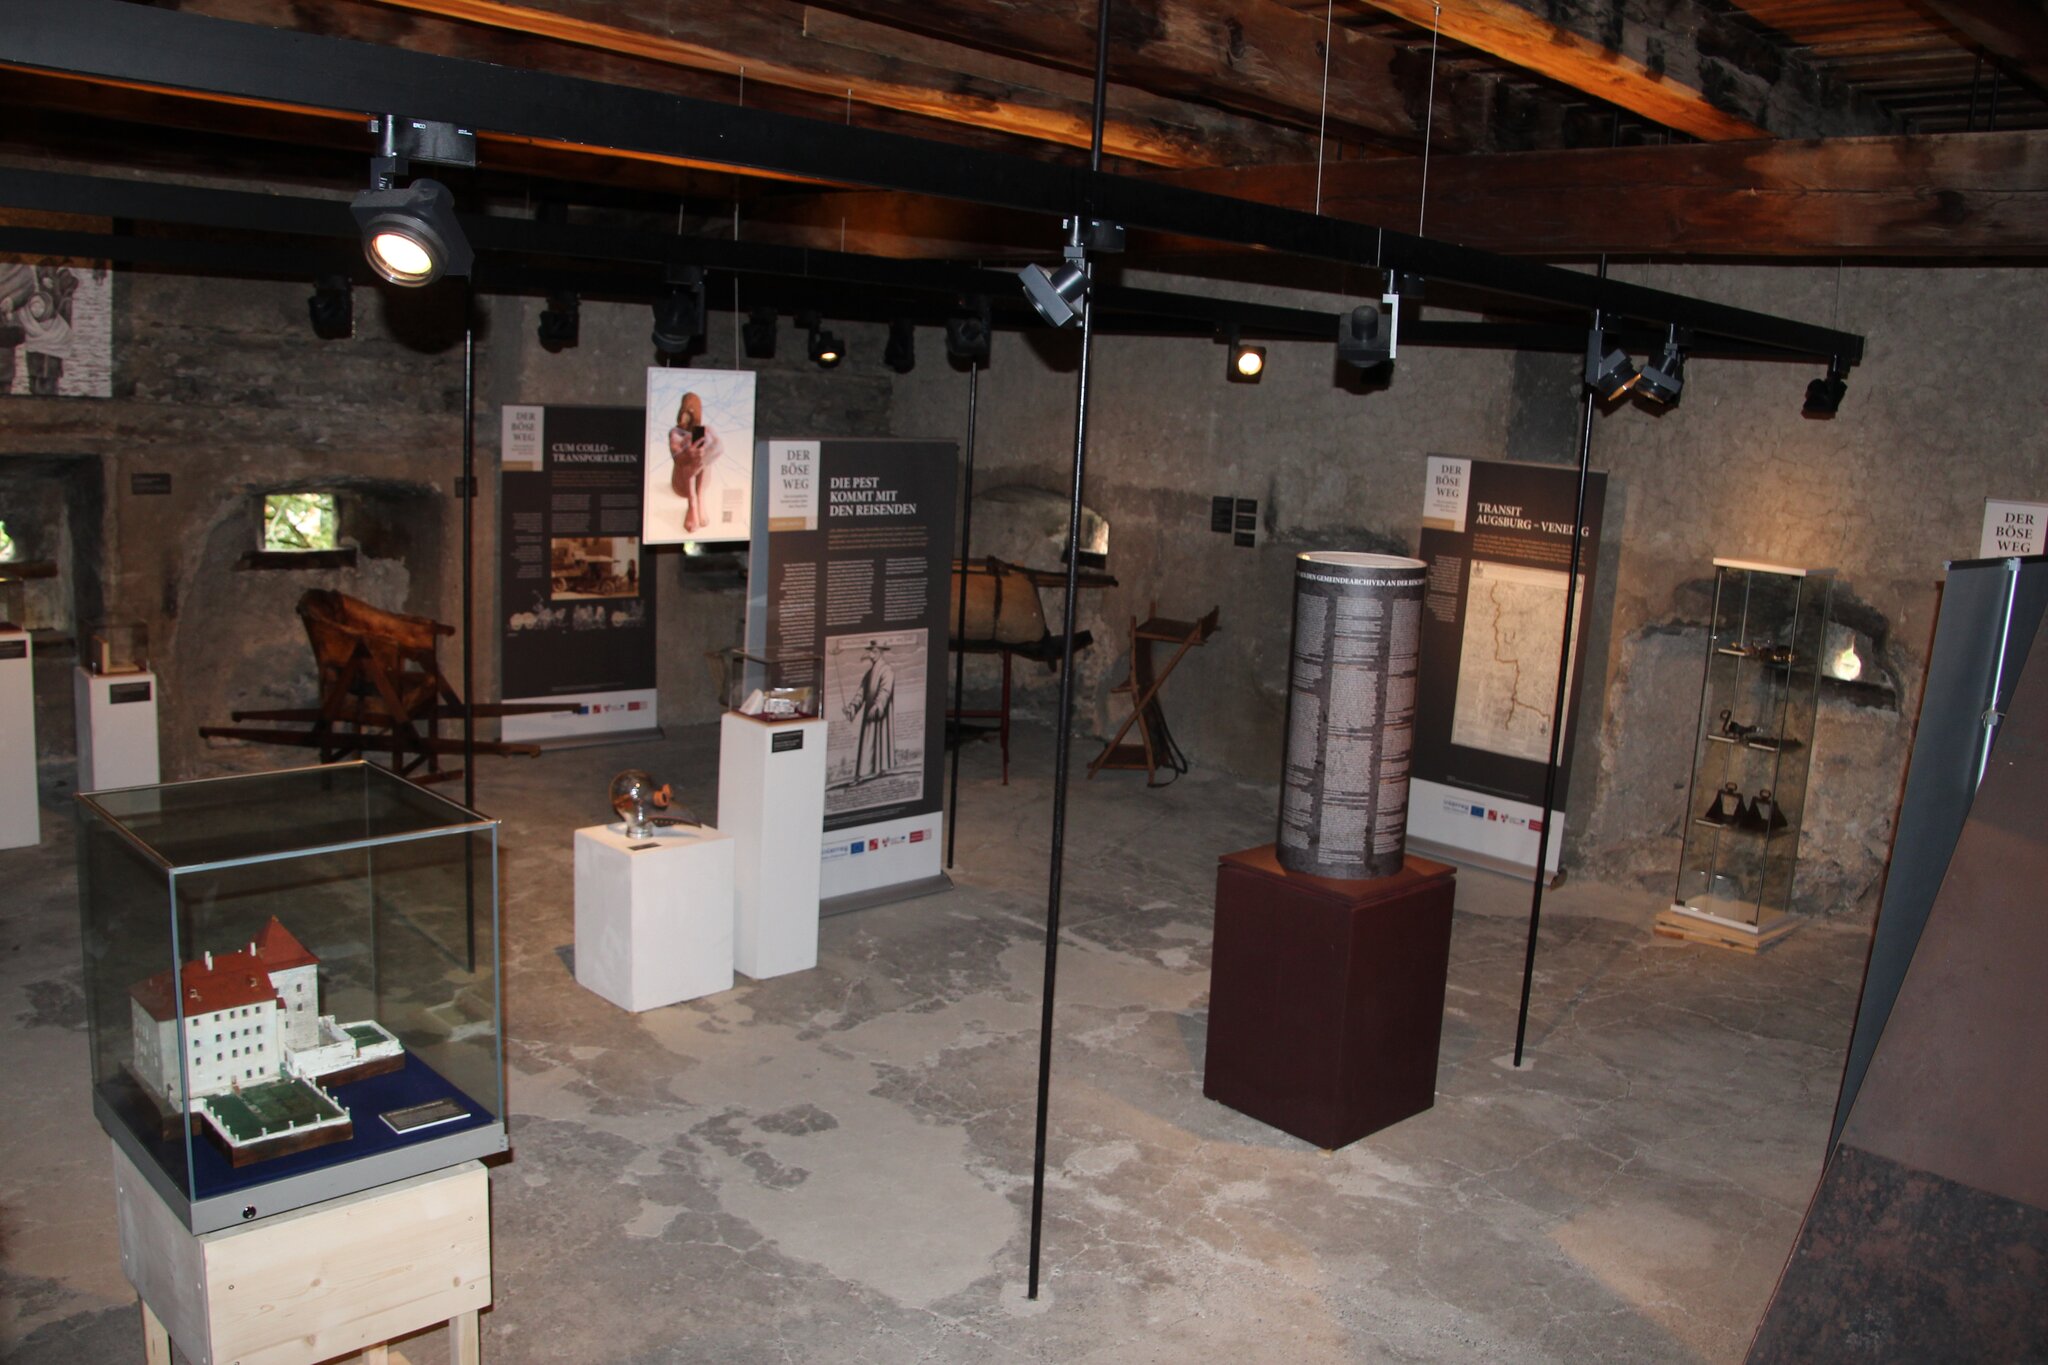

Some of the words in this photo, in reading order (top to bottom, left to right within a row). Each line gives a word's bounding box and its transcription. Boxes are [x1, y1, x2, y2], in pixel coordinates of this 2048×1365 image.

[516, 412, 536, 421] DER
[513, 433, 536, 442] WEG
[552, 443, 575, 453] CUM
[576, 443, 608, 453] COLLO
[552, 453, 638, 463] TRANSPORTARTEN
[787, 449, 810, 461] DER
[781, 463, 809, 476] BÖSE
[1441, 464, 1462, 475] DER
[783, 478, 809, 490] WEG
[830, 477, 851, 489] DIE
[852, 476, 879, 489] PEST
[1435, 475, 1460, 487] BÖSE
[830, 491, 874, 503] KOMMT
[875, 490, 898, 502] MIT
[1437, 487, 1460, 498] WEG
[829, 505, 853, 517] DEN
[855, 503, 917, 516] REISENDEN
[1477, 502, 1522, 517] TRANSIT
[2005, 512, 2034, 525] DER
[1476, 515, 1532, 530] AUGSBURG
[1541, 521, 1589, 537] VENEG
[1996, 525, 2033, 539] BÖSE
[1998, 540, 2031, 553] WEG
[1316, 574, 1386, 587] GEMEINDEARCHIVEN
[1386, 579, 1396, 587] AN
